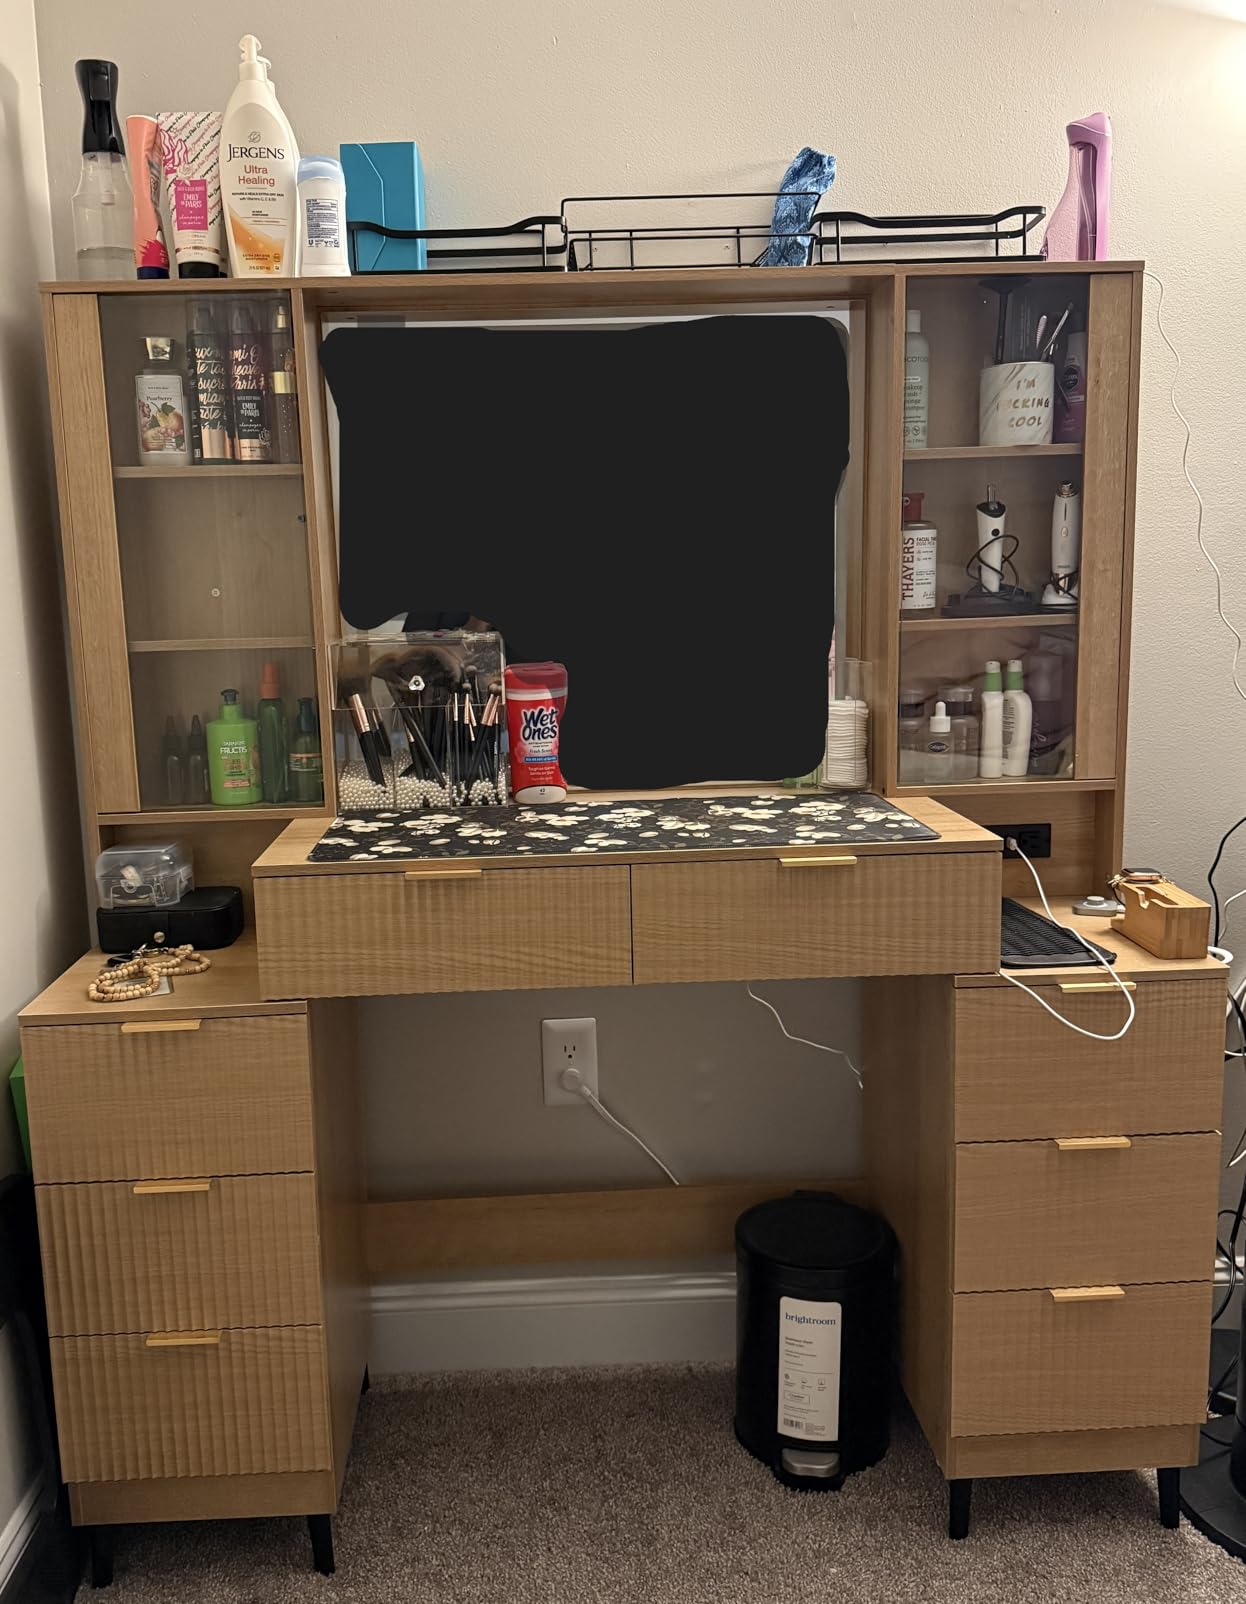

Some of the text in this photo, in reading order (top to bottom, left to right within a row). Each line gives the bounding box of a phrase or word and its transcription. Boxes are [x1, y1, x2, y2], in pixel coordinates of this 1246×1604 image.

[226, 144, 285, 162] JERGENS
[244, 165, 268, 174] Ultra
[238, 176, 275, 187] Healing
[185, 200, 202, 208] PARIS
[1016, 378, 1036, 390] I'M
[1008, 416, 1042, 428] COOL
[902, 537, 914, 600] THAYERS
[524, 708, 558, 728] Wet
[522, 724, 558, 741] Ones
[785, 1312, 836, 1325] brightroom
